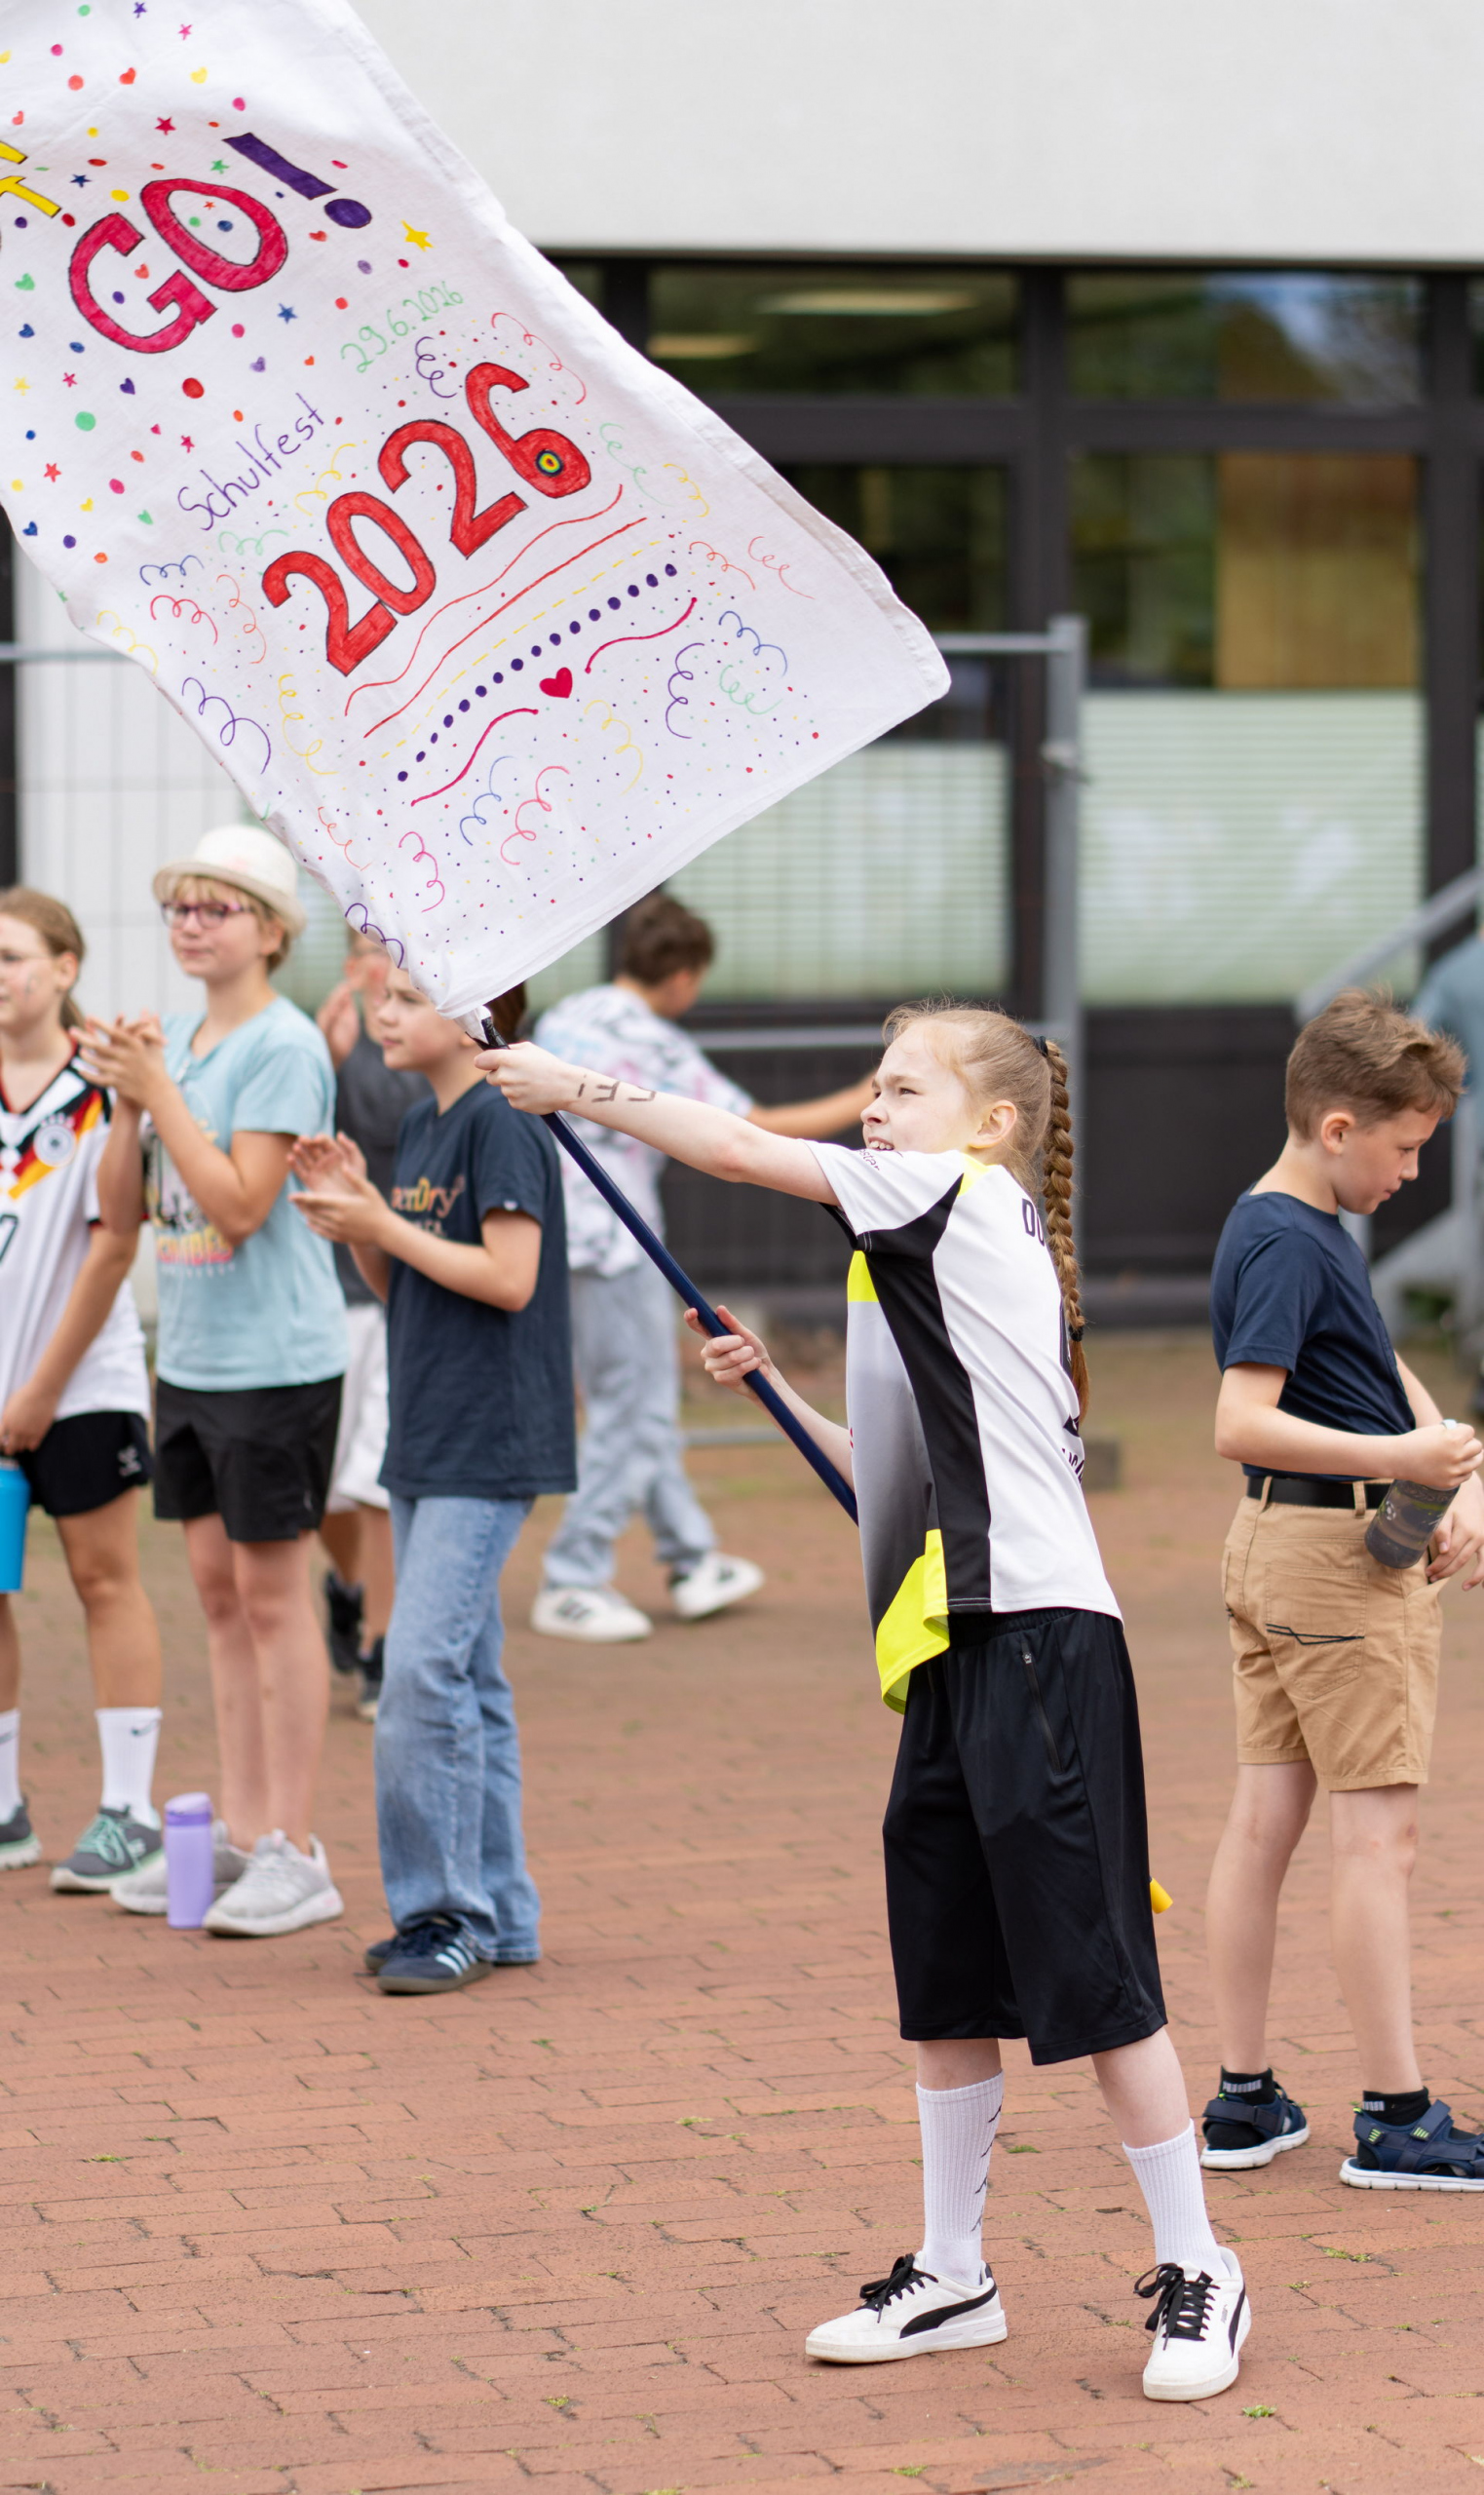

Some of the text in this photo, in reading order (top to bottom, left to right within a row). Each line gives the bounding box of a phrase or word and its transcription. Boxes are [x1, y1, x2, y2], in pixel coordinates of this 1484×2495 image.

[340, 280, 464, 373] 29.6.2026
[177, 392, 324, 531] Schulfest
[261, 362, 591, 676] 2026
